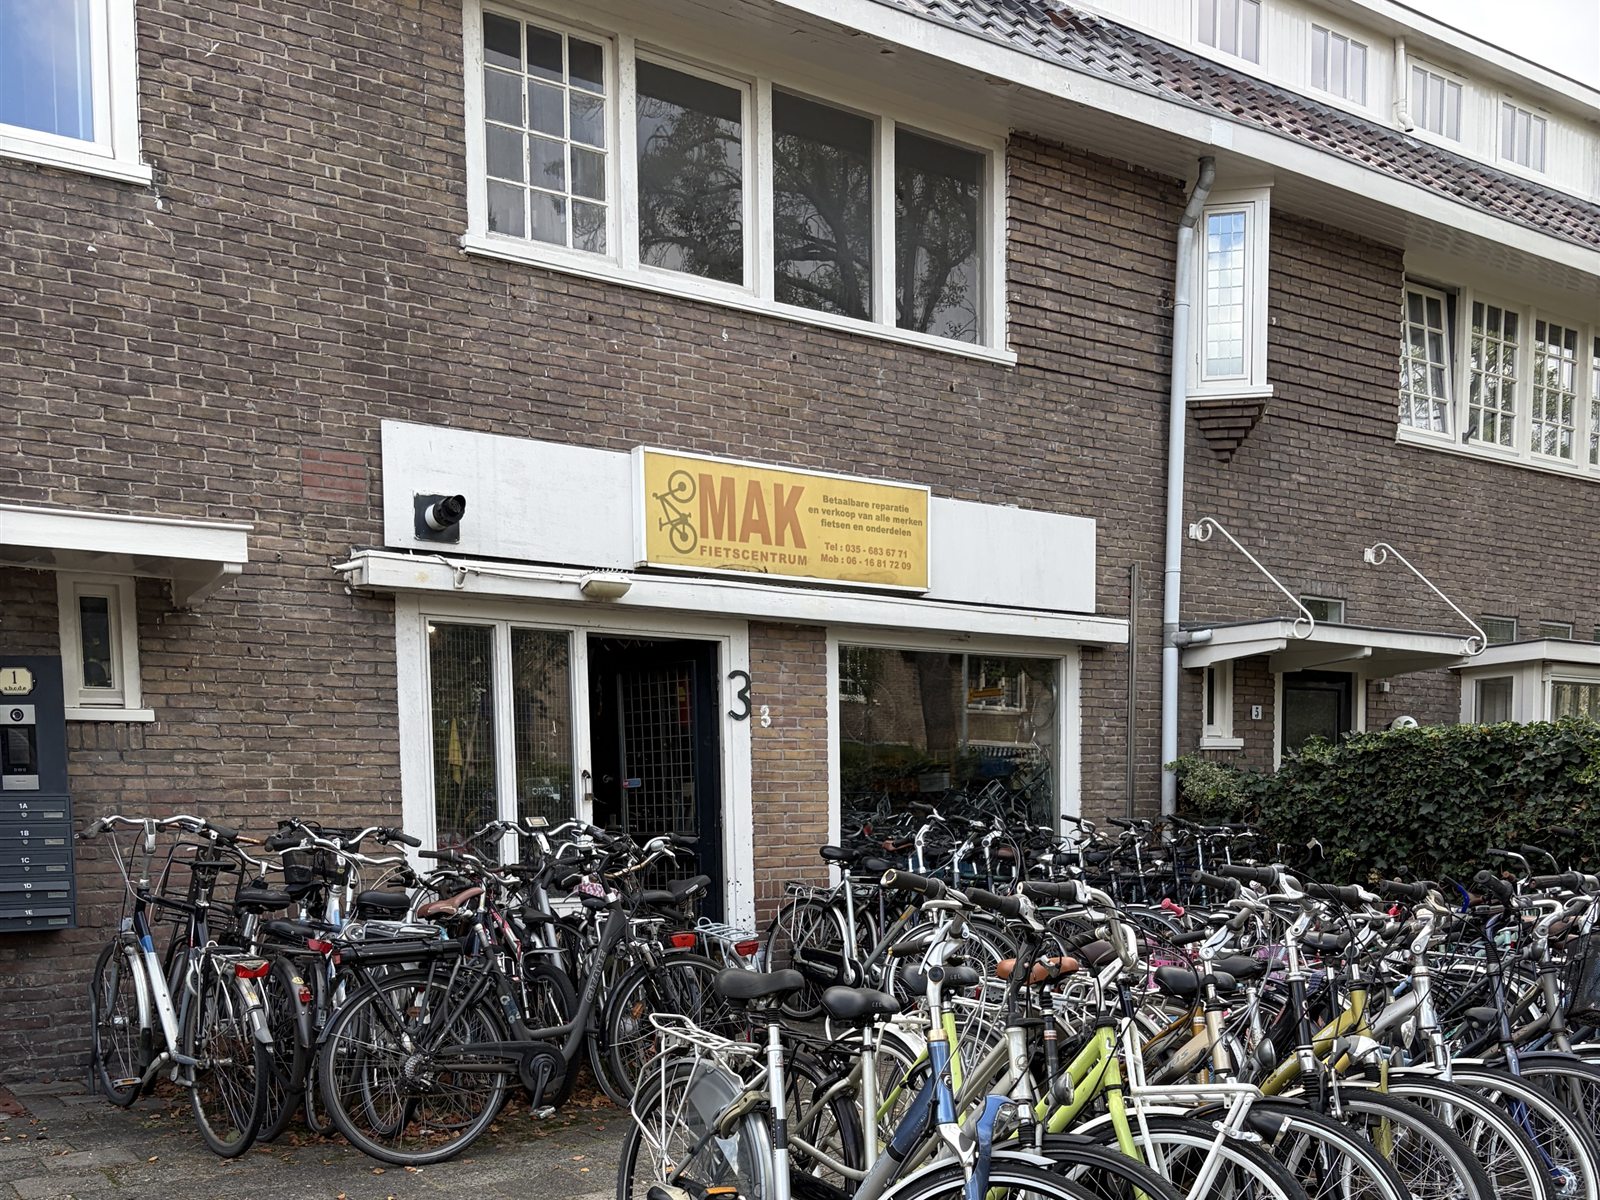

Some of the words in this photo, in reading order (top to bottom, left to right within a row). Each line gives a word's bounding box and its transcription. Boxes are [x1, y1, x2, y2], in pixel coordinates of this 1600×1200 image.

[698, 474, 807, 549] MAK
[822, 495, 870, 509] Betaalbare
[871, 500, 909, 514] reparatie
[821, 507, 856, 520] verkoop
[858, 512, 873, 520] van
[875, 512, 890, 522] alle
[892, 515, 922, 526] merken
[820, 519, 850, 531] fietsen
[866, 524, 912, 537] onderdelen
[700, 545, 807, 566] FIETSCENTRUM
[824, 542, 838, 552] Tel
[845, 543, 861, 554] 035
[868, 546, 883, 556] 683
[885, 548, 896, 557] 67
[897, 548, 908, 558] 71
[820, 554, 839, 564] Mob
[846, 556, 857, 565] 06
[864, 558, 874, 567] 16
[876, 559, 886, 568] 81
[889, 560, 899, 569] 72
[901, 561, 912, 570] 09
[13, 671, 17, 684] 1
[728, 670, 751, 721] 3
[1254, 706, 1259, 718] 5
